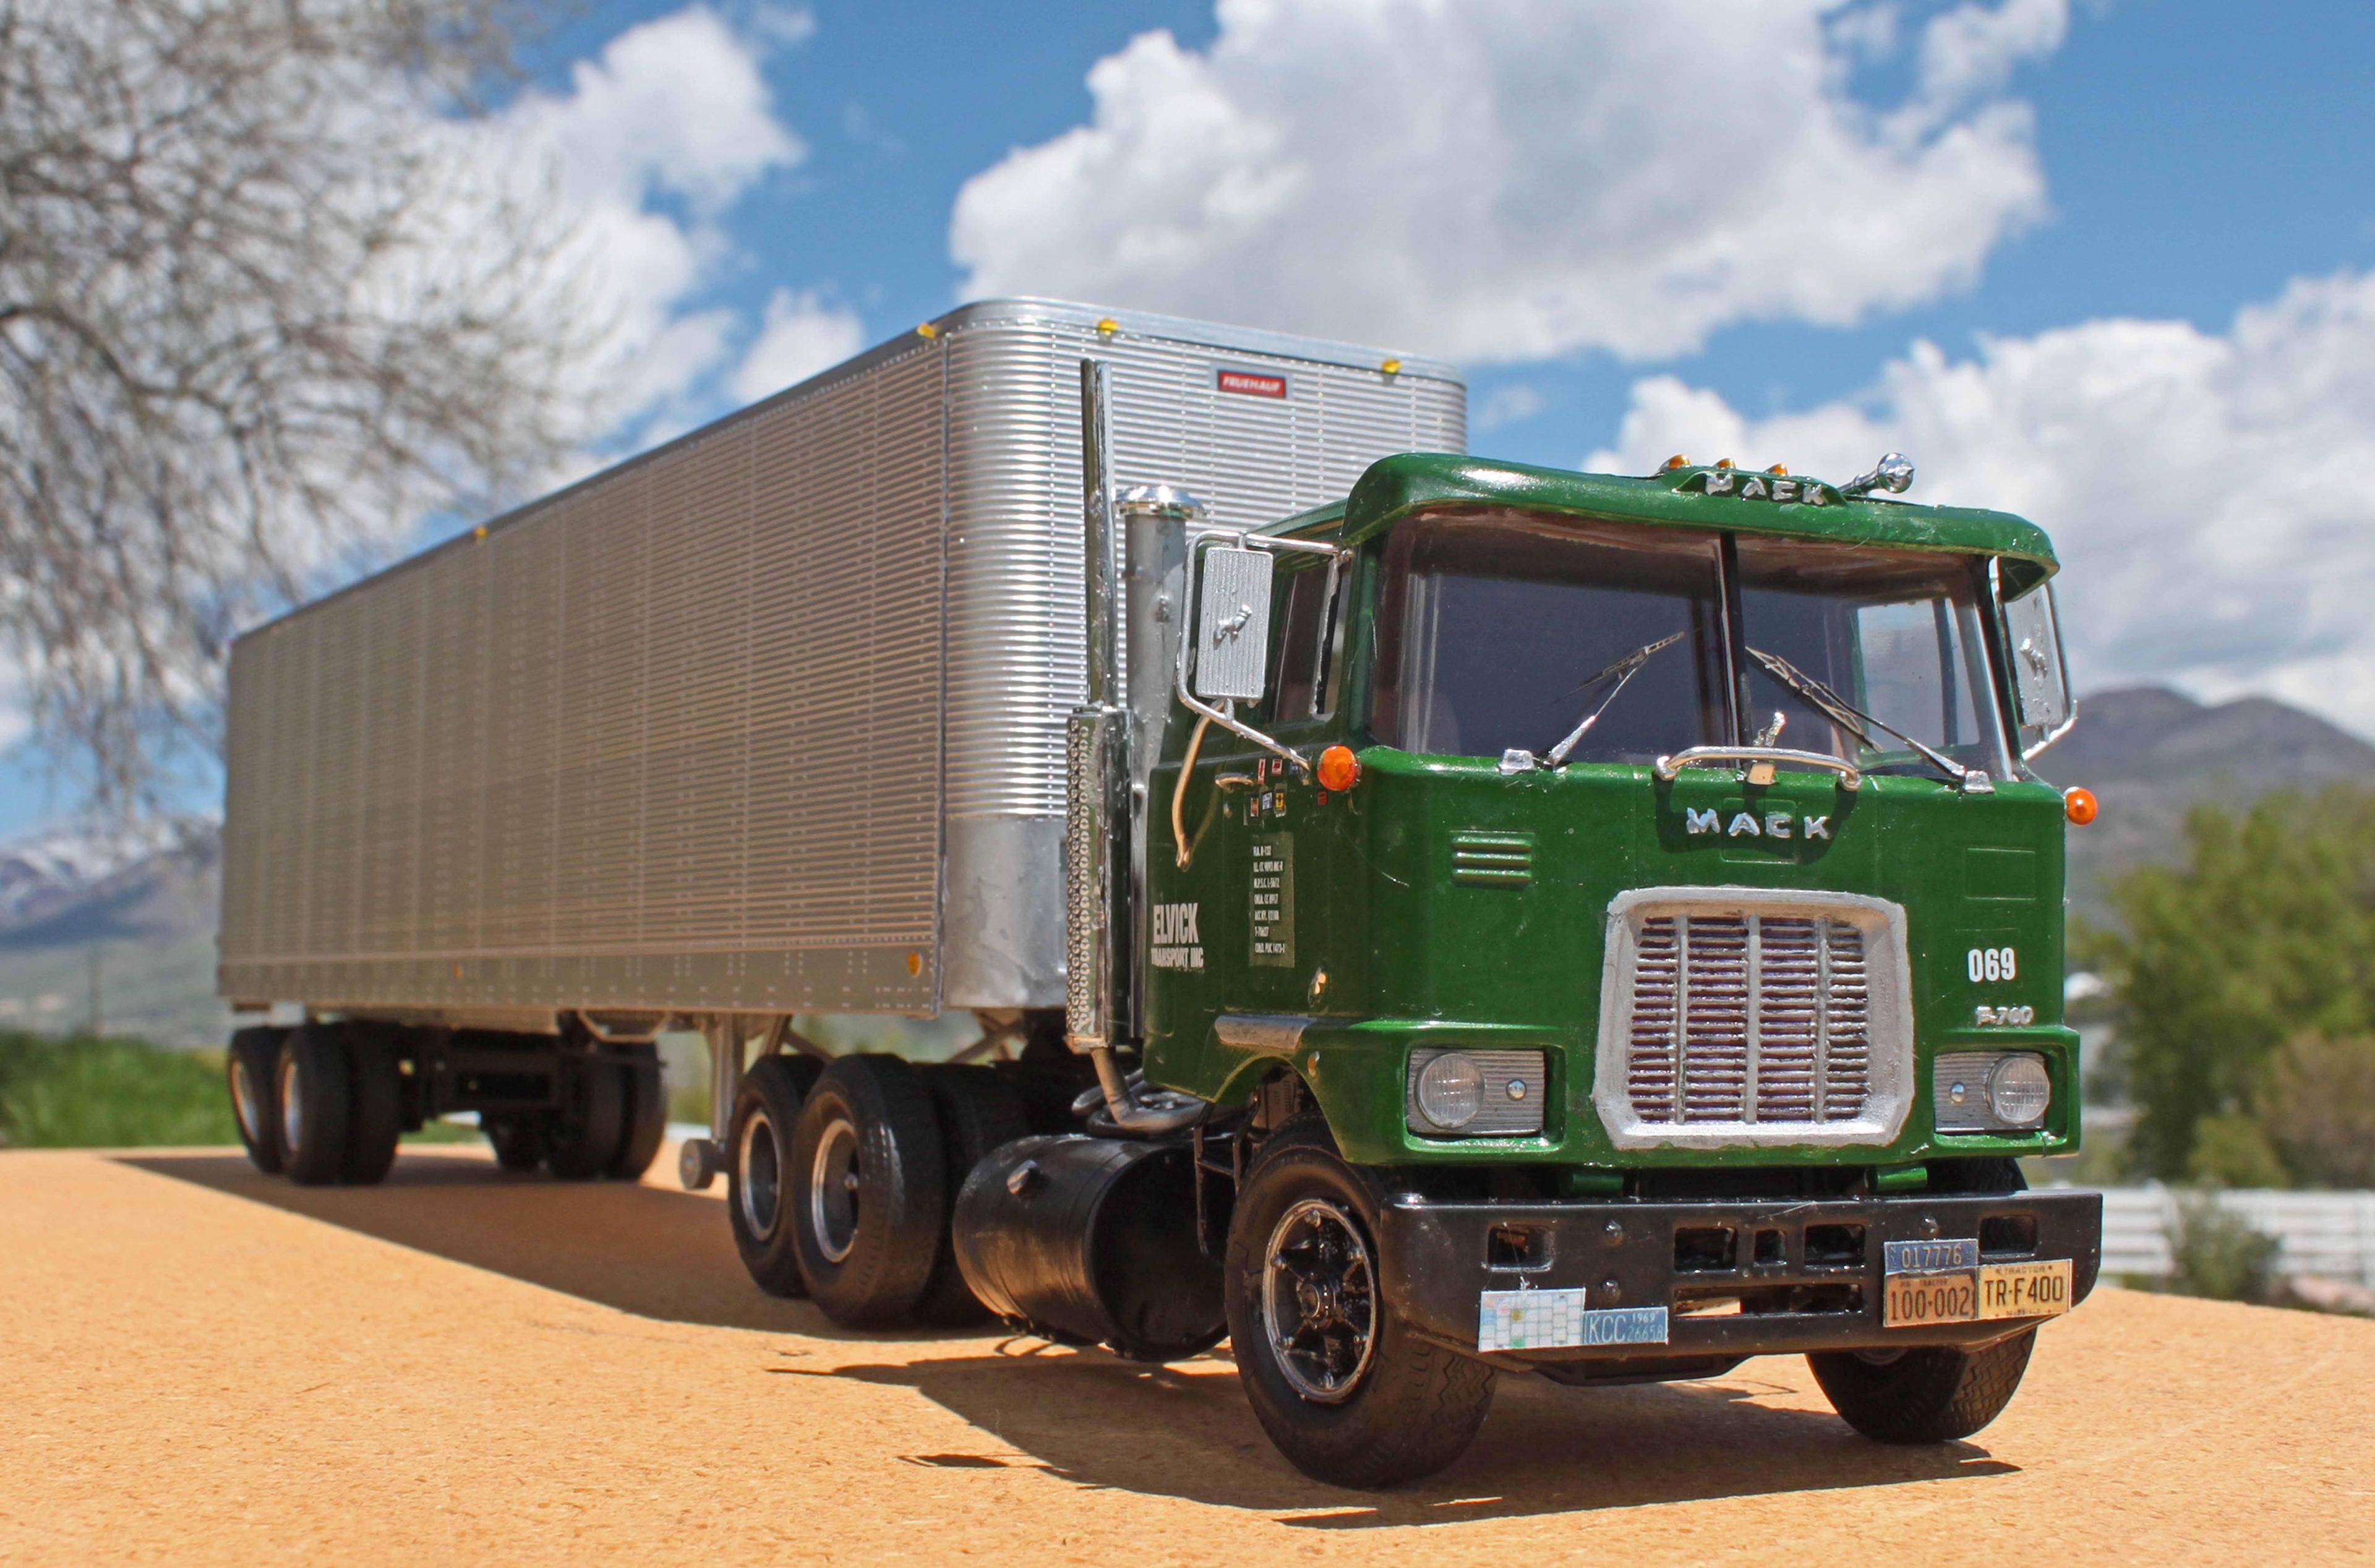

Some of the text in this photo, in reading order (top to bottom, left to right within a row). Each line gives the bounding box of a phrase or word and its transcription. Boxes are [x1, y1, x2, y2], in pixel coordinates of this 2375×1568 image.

[1222, 375, 1282, 392] FRUEHAUF
[1687, 807, 1830, 839] MACK
[1153, 902, 1199, 945] ELVICK
[1150, 947, 1204, 969] TRANSPORT INC
[1967, 947, 2016, 983] 069
[1901, 1246, 1962, 1269] 017776
[1590, 1314, 1627, 1343] KCC
